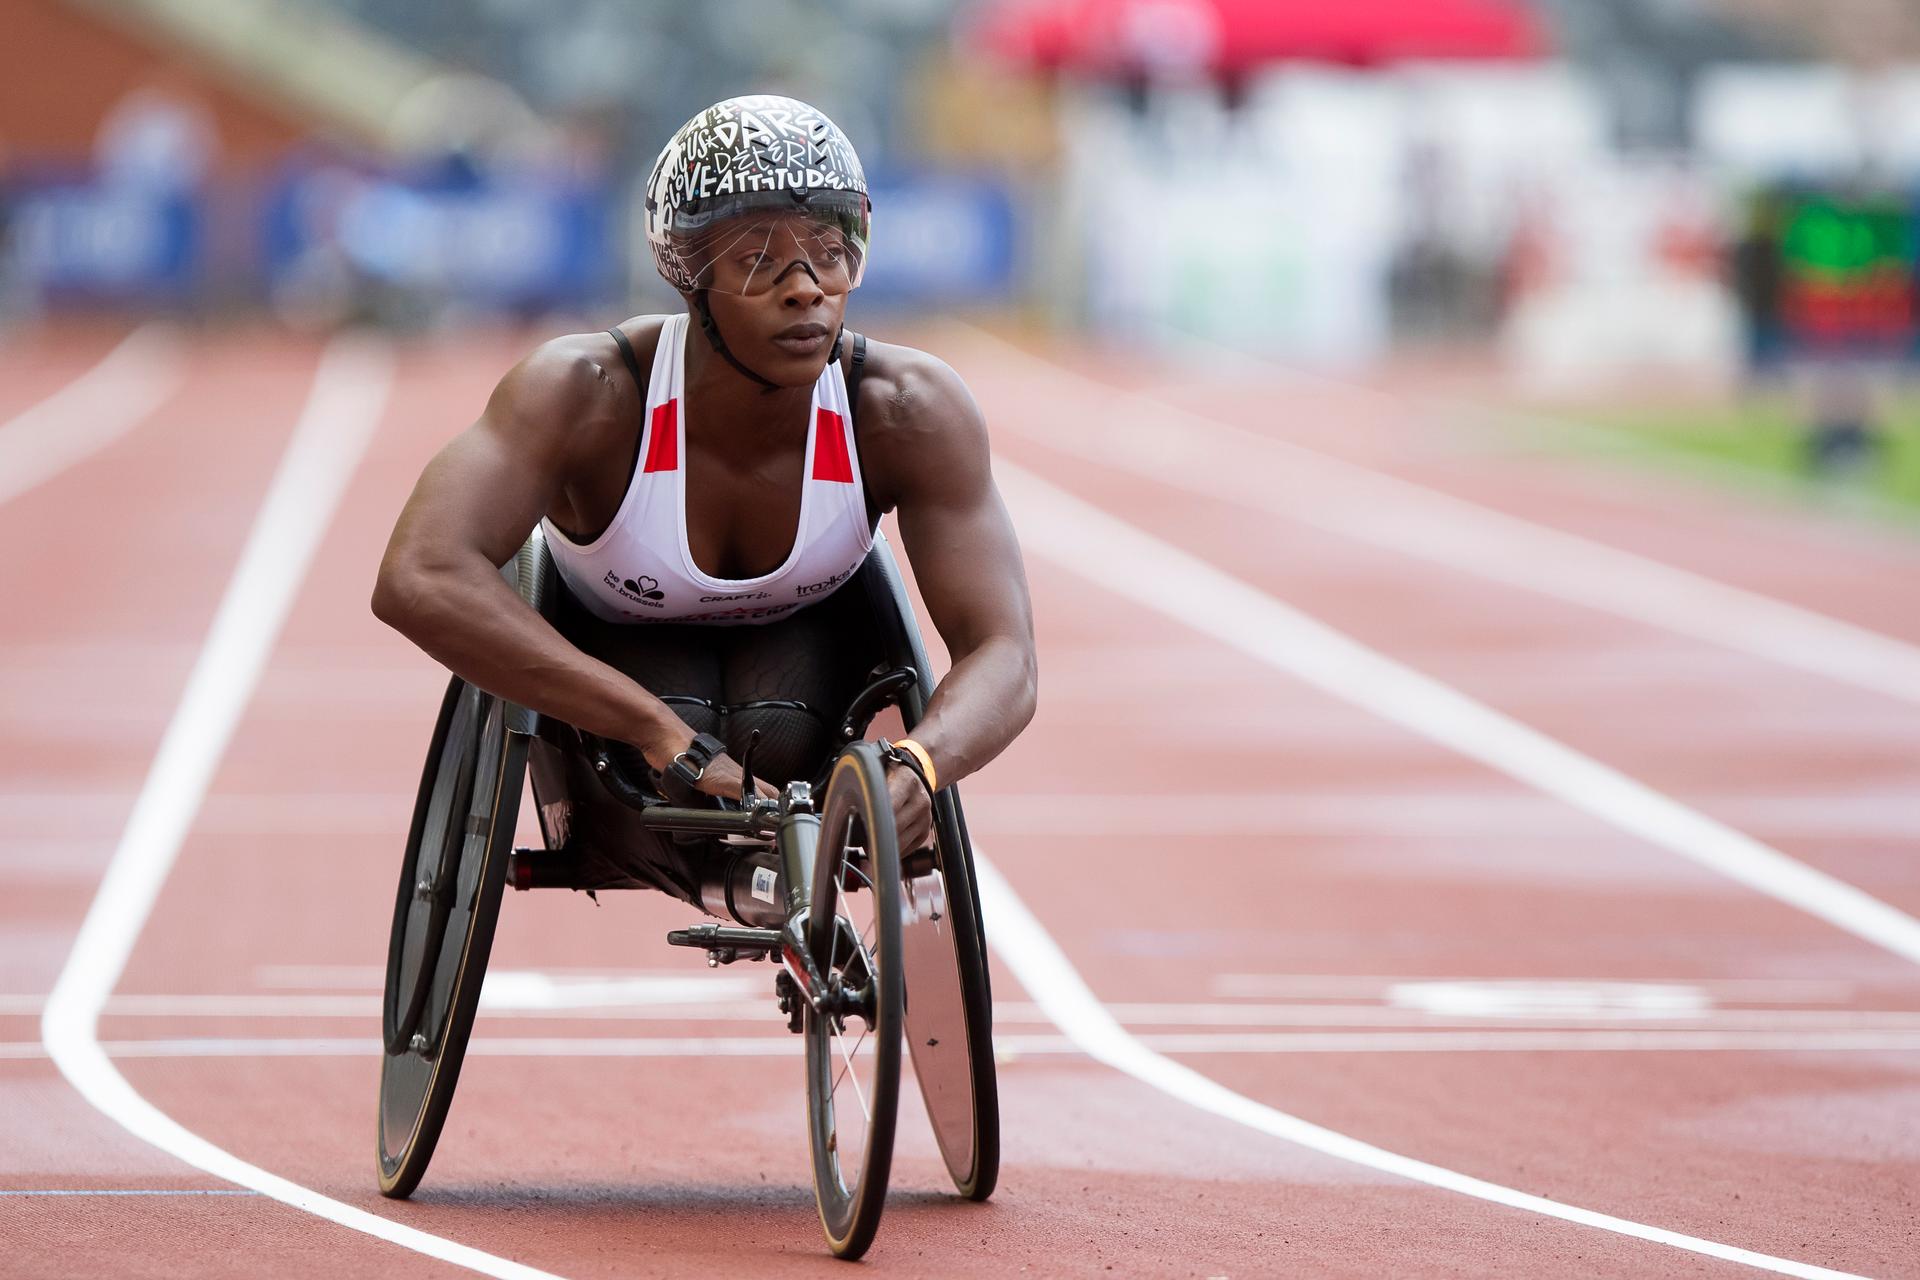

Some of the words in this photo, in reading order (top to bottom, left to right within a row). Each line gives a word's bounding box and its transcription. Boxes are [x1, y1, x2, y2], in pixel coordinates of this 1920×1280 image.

[714, 109, 830, 149] DARE
[607, 569, 620, 584] be
[603, 576, 665, 609] be.brussels
[699, 594, 756, 603] CRAFT
